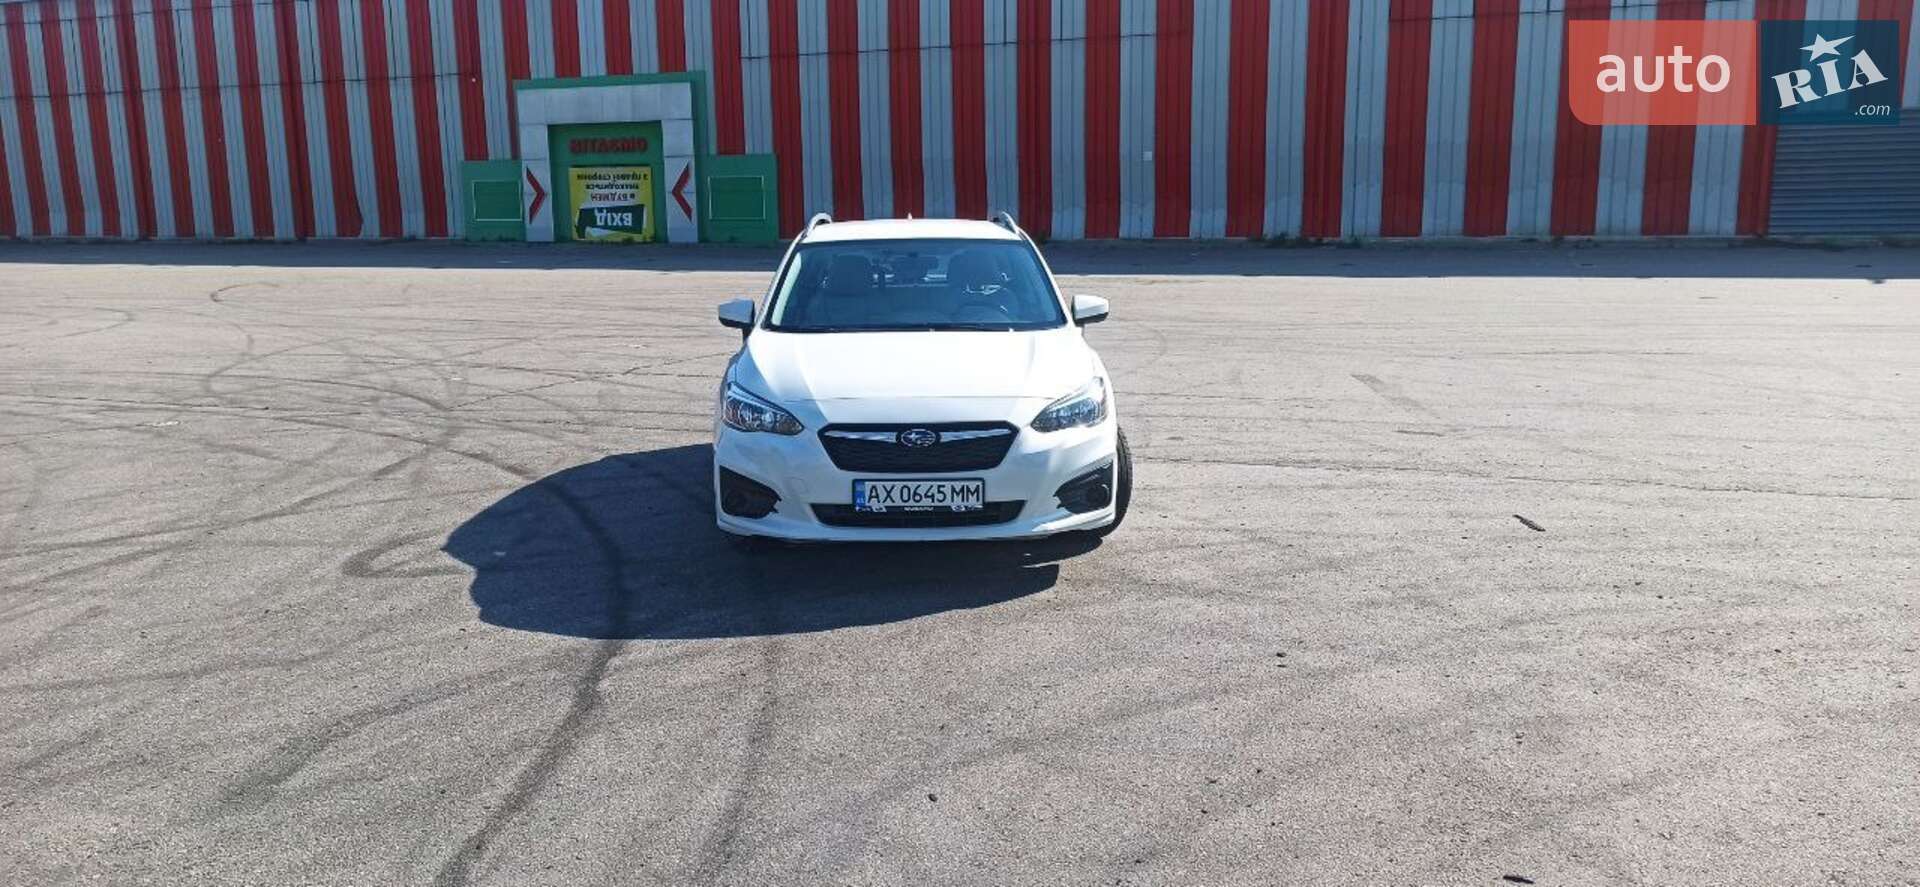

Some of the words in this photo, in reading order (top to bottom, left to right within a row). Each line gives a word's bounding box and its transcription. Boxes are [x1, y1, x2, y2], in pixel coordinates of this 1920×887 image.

[595, 207, 632, 226] ВХІД
[867, 485, 896, 503] AX
[900, 485, 946, 503] 0645
[951, 485, 980, 503] MM
